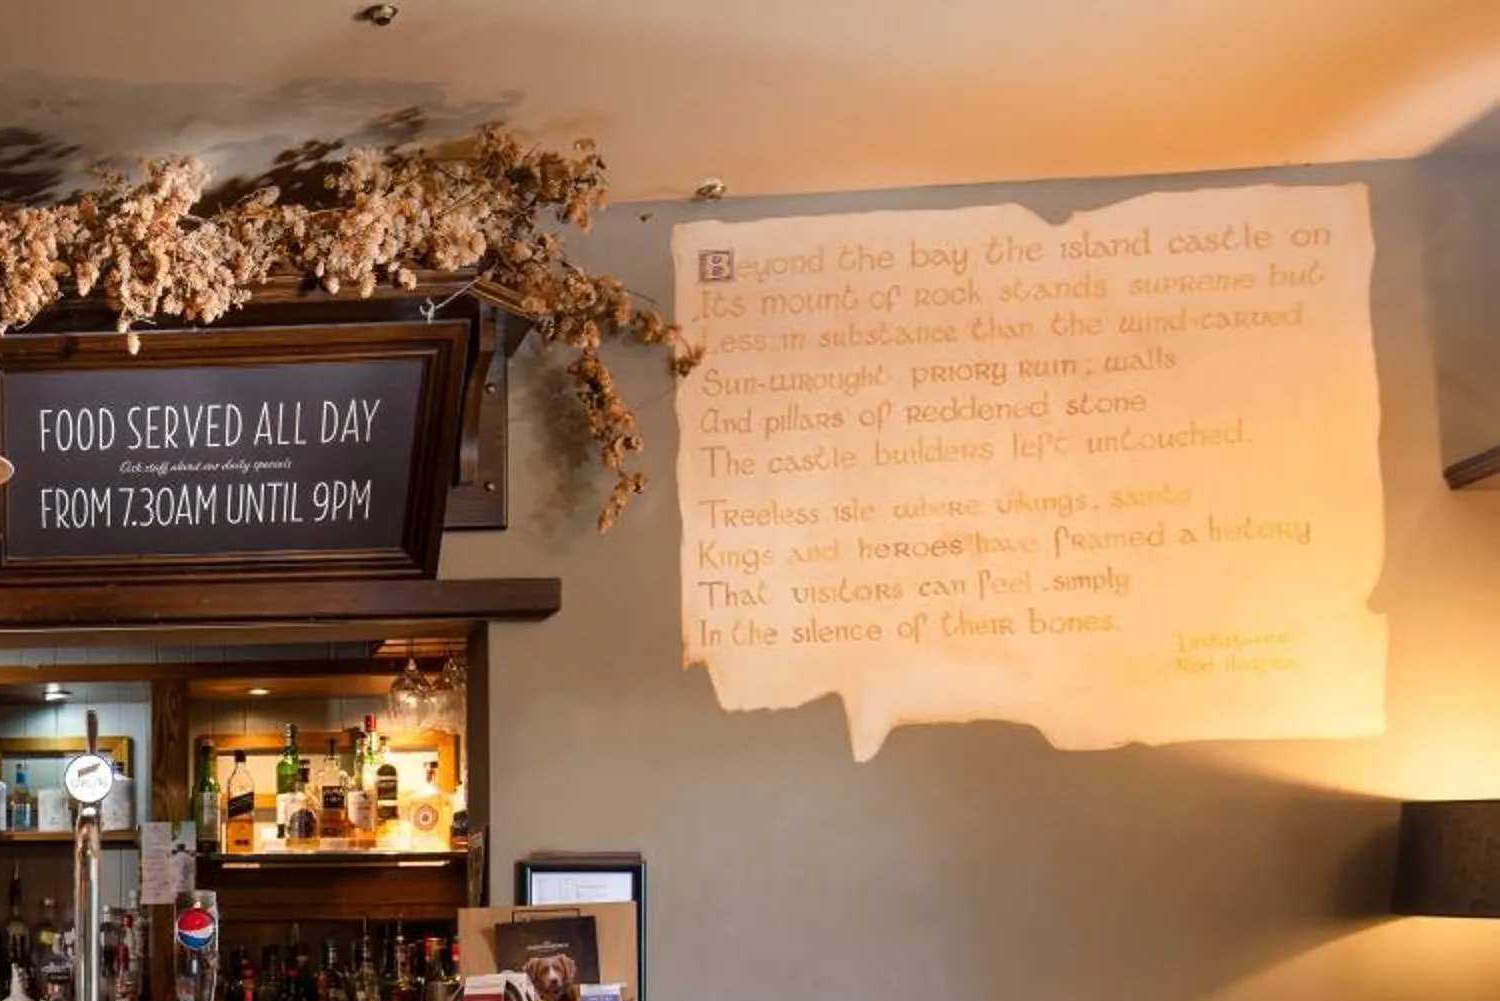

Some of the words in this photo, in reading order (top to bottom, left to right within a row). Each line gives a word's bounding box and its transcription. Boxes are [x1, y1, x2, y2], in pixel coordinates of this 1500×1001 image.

[838, 241, 895, 273] the
[910, 239, 969, 275] bay
[985, 235, 1045, 264] the
[1059, 227, 1152, 261] island
[1167, 222, 1273, 255] castle
[1289, 226, 1332, 249] on
[701, 289, 747, 319] Its
[761, 284, 858, 316] mount
[869, 284, 901, 313] of
[999, 271, 1108, 302] stands
[1269, 260, 1325, 289] but
[781, 331, 805, 350] in
[818, 323, 958, 349] substance
[971, 315, 1034, 341] than
[1050, 309, 1103, 337] the
[1103, 346, 1177, 373] walls
[40, 406, 117, 453] FOOD
[127, 403, 244, 449] SERVED
[253, 400, 308, 446] ALL
[319, 397, 382, 444] DAY
[700, 407, 752, 434] And
[764, 403, 845, 441] pillars
[858, 399, 893, 433] of
[1065, 391, 1148, 416] stone
[698, 445, 757, 479] The
[767, 445, 858, 475] castle
[874, 435, 995, 466] builders
[1012, 428, 1071, 461] left
[41, 486, 112, 529] FROM
[117, 483, 218, 528] 7.30AM
[226, 480, 304, 525] UNTIL
[312, 478, 373, 523] 9PM
[834, 498, 876, 522] isle
[698, 538, 774, 575] Kings
[787, 535, 840, 564] and
[1053, 520, 1166, 560] framed
[1178, 527, 1199, 545] a
[697, 580, 773, 610] That
[790, 575, 903, 604] visitors
[918, 577, 966, 598] can
[700, 618, 722, 648] In
[731, 617, 779, 647] the
[791, 615, 884, 645] silence
[896, 612, 928, 645] of
[939, 608, 1016, 639] their
[1027, 607, 1122, 636] bones.
